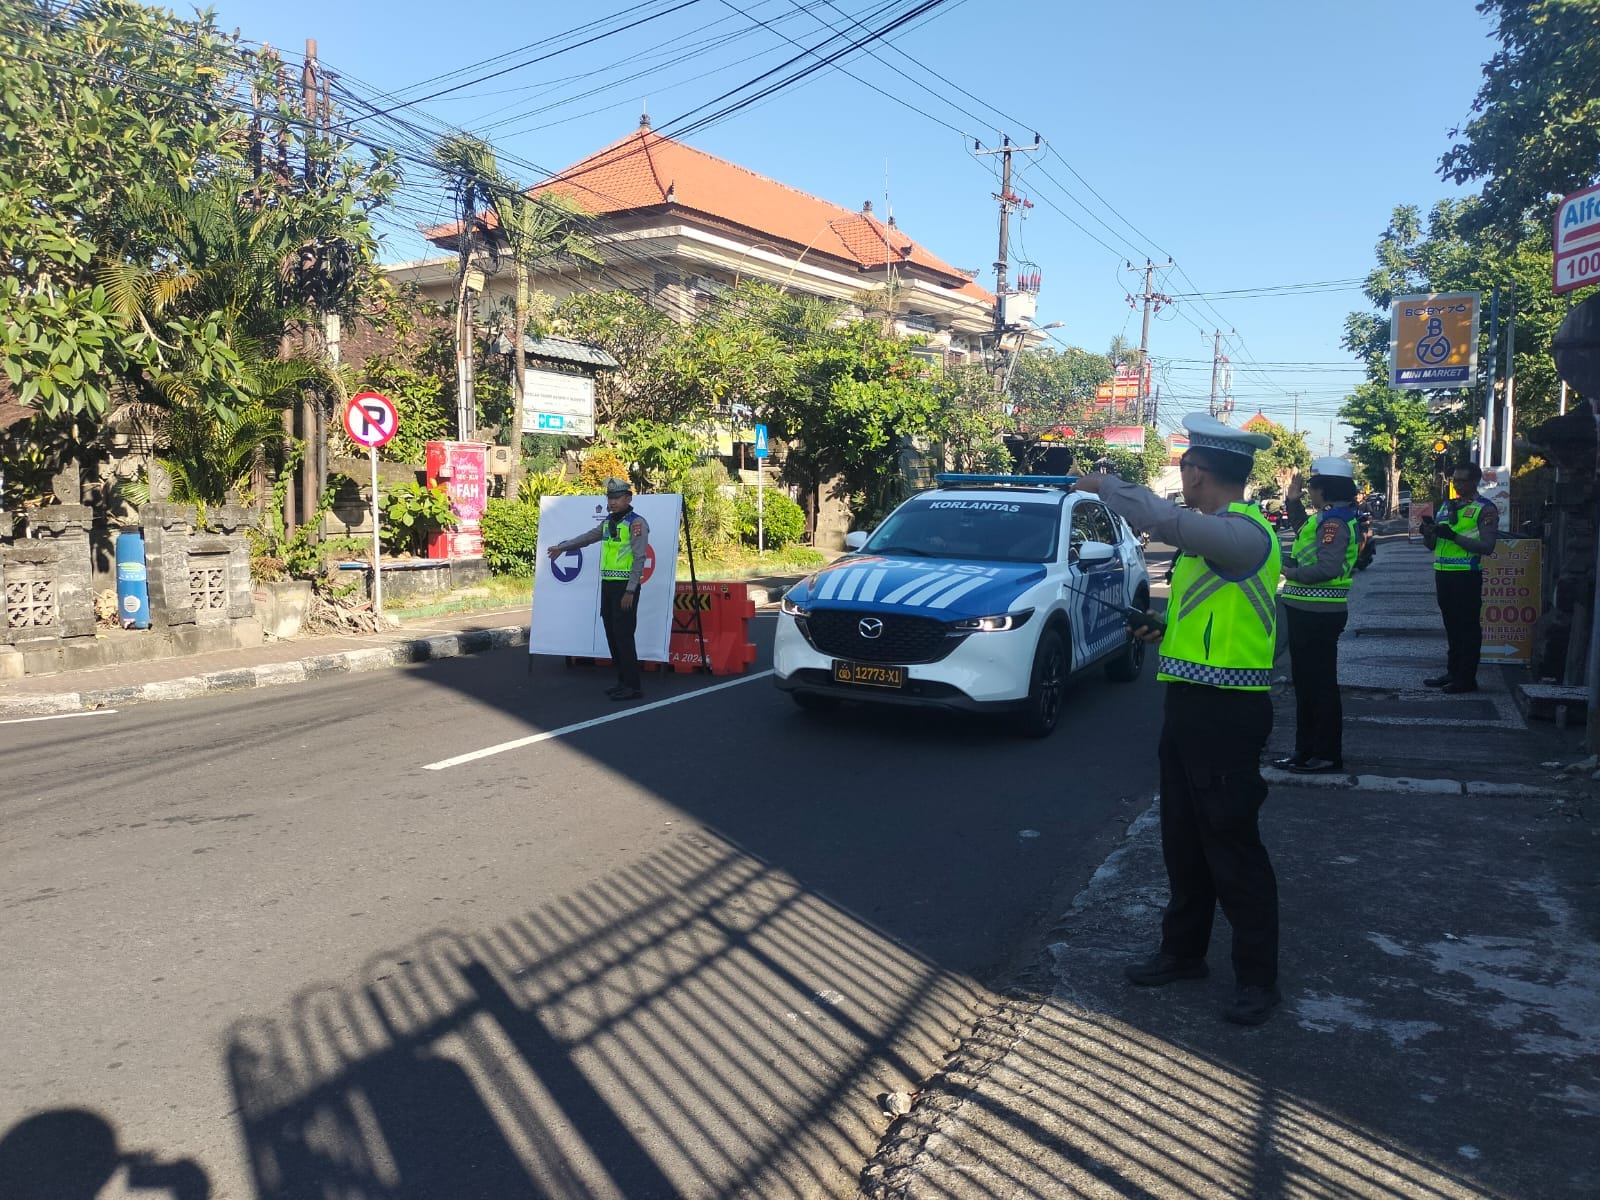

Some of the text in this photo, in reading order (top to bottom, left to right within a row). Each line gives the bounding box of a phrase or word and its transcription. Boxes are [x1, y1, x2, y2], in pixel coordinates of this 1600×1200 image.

[1405, 303, 1466, 317] BOBY 76
[1401, 369, 1464, 379] MINI MARKET
[456, 484, 480, 498] FAH
[929, 501, 1021, 513] KORLANTAS
[868, 560, 1001, 577] OLISI
[1495, 567, 1525, 576] TEH
[1482, 577, 1516, 586] POCI
[1481, 587, 1530, 597] UMBO
